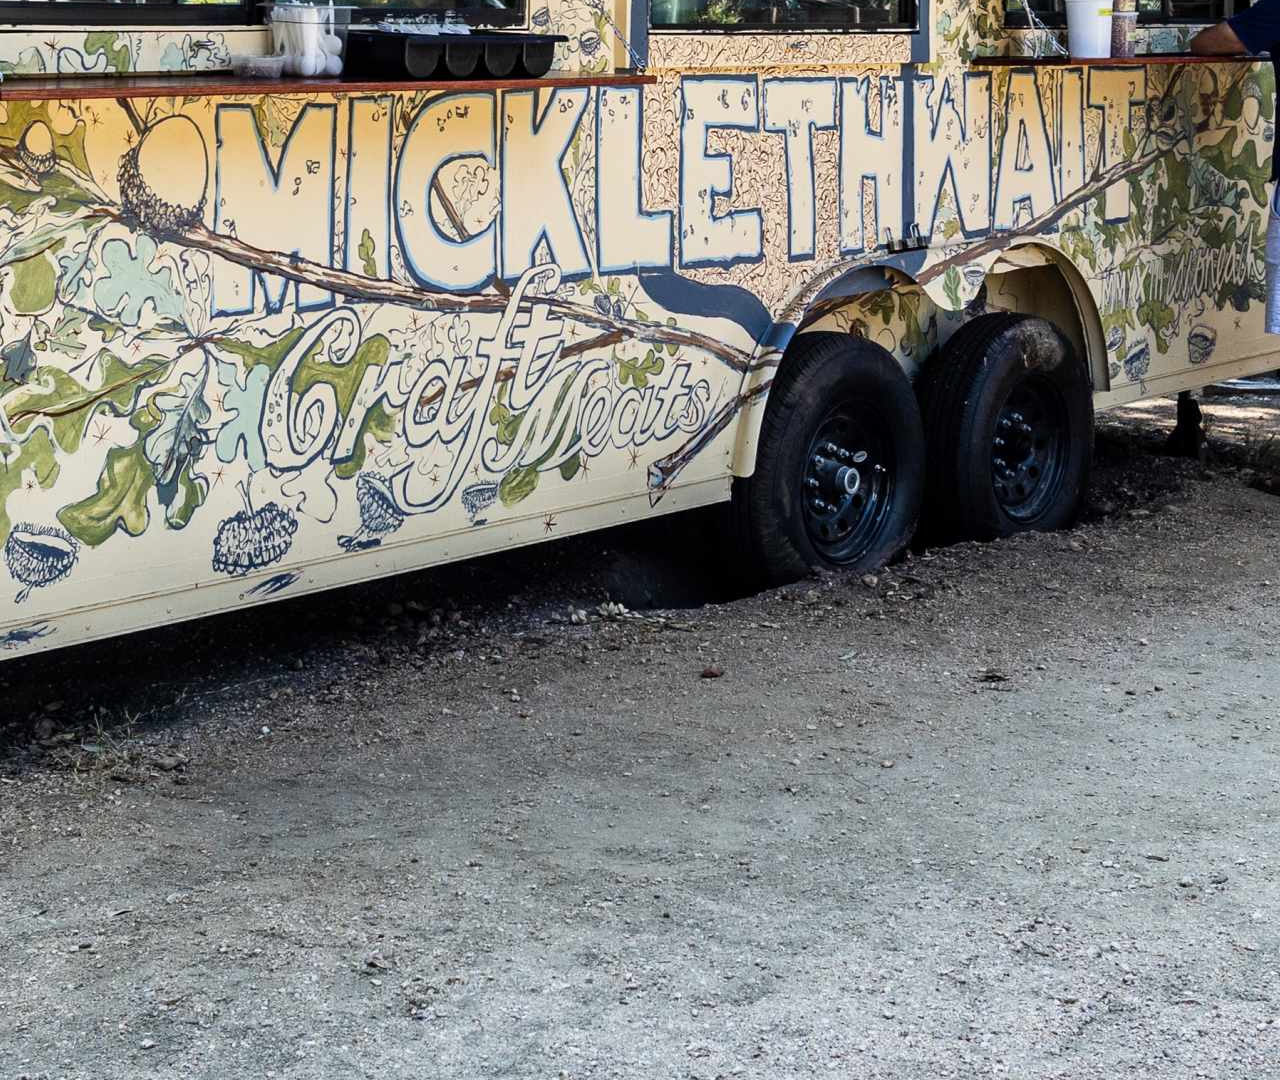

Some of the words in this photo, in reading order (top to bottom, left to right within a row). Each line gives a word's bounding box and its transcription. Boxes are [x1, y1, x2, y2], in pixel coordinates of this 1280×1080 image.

[212, 64, 1148, 320] MICKLETHWAIT
[261, 262, 571, 515] Craft
[484, 357, 712, 471] Meats
